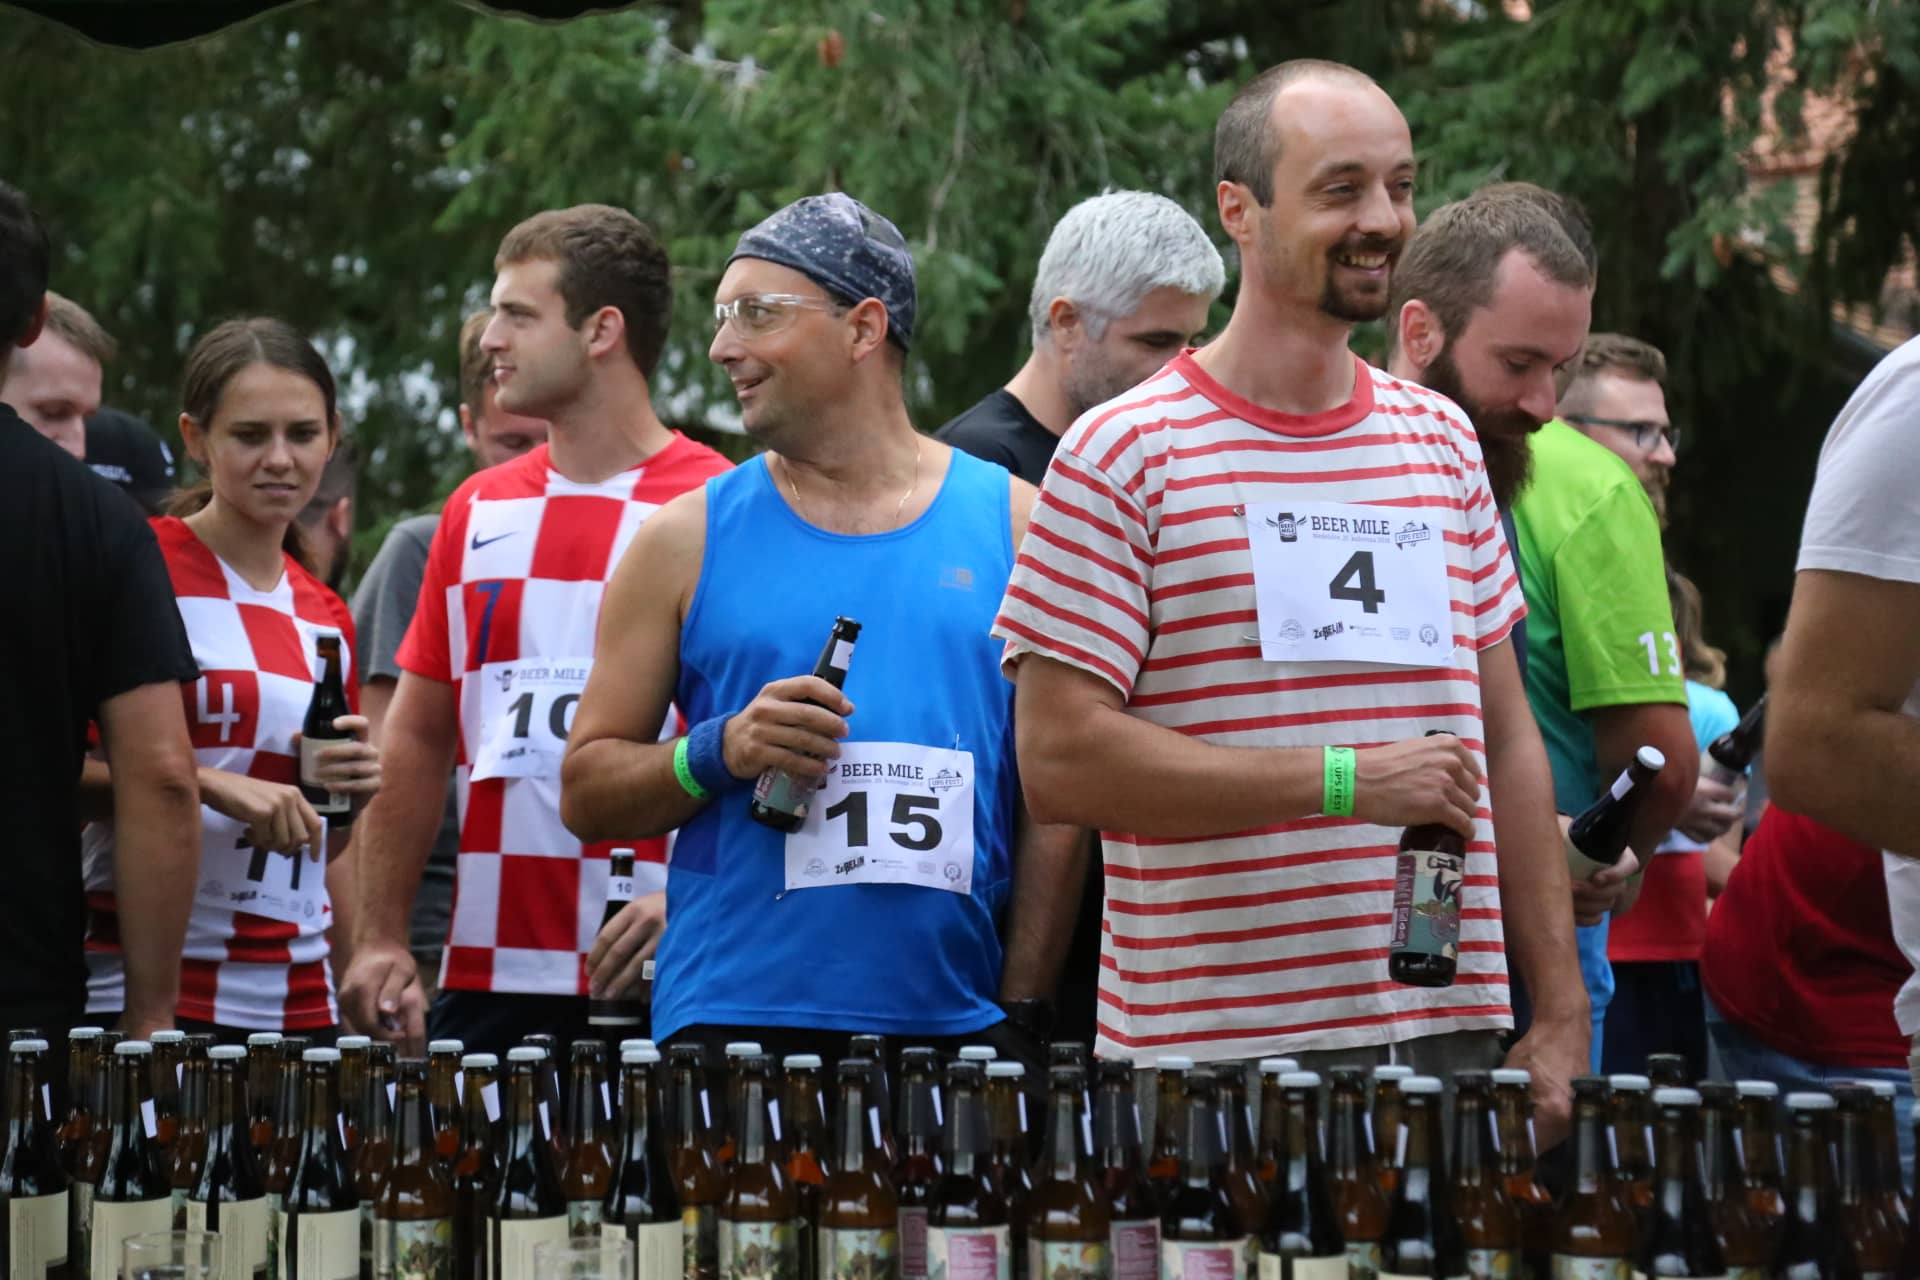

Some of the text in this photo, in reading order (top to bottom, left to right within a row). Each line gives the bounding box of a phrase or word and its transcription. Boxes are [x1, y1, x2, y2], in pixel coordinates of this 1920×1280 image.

[1311, 516, 1390, 535] BEER MILE
[1329, 551, 1385, 614] 4
[519, 668, 586, 680] BEER MILE
[1638, 631, 1681, 676] 13
[195, 675, 241, 742] 4
[841, 763, 924, 780] BEER MILE
[826, 791, 943, 851] 15
